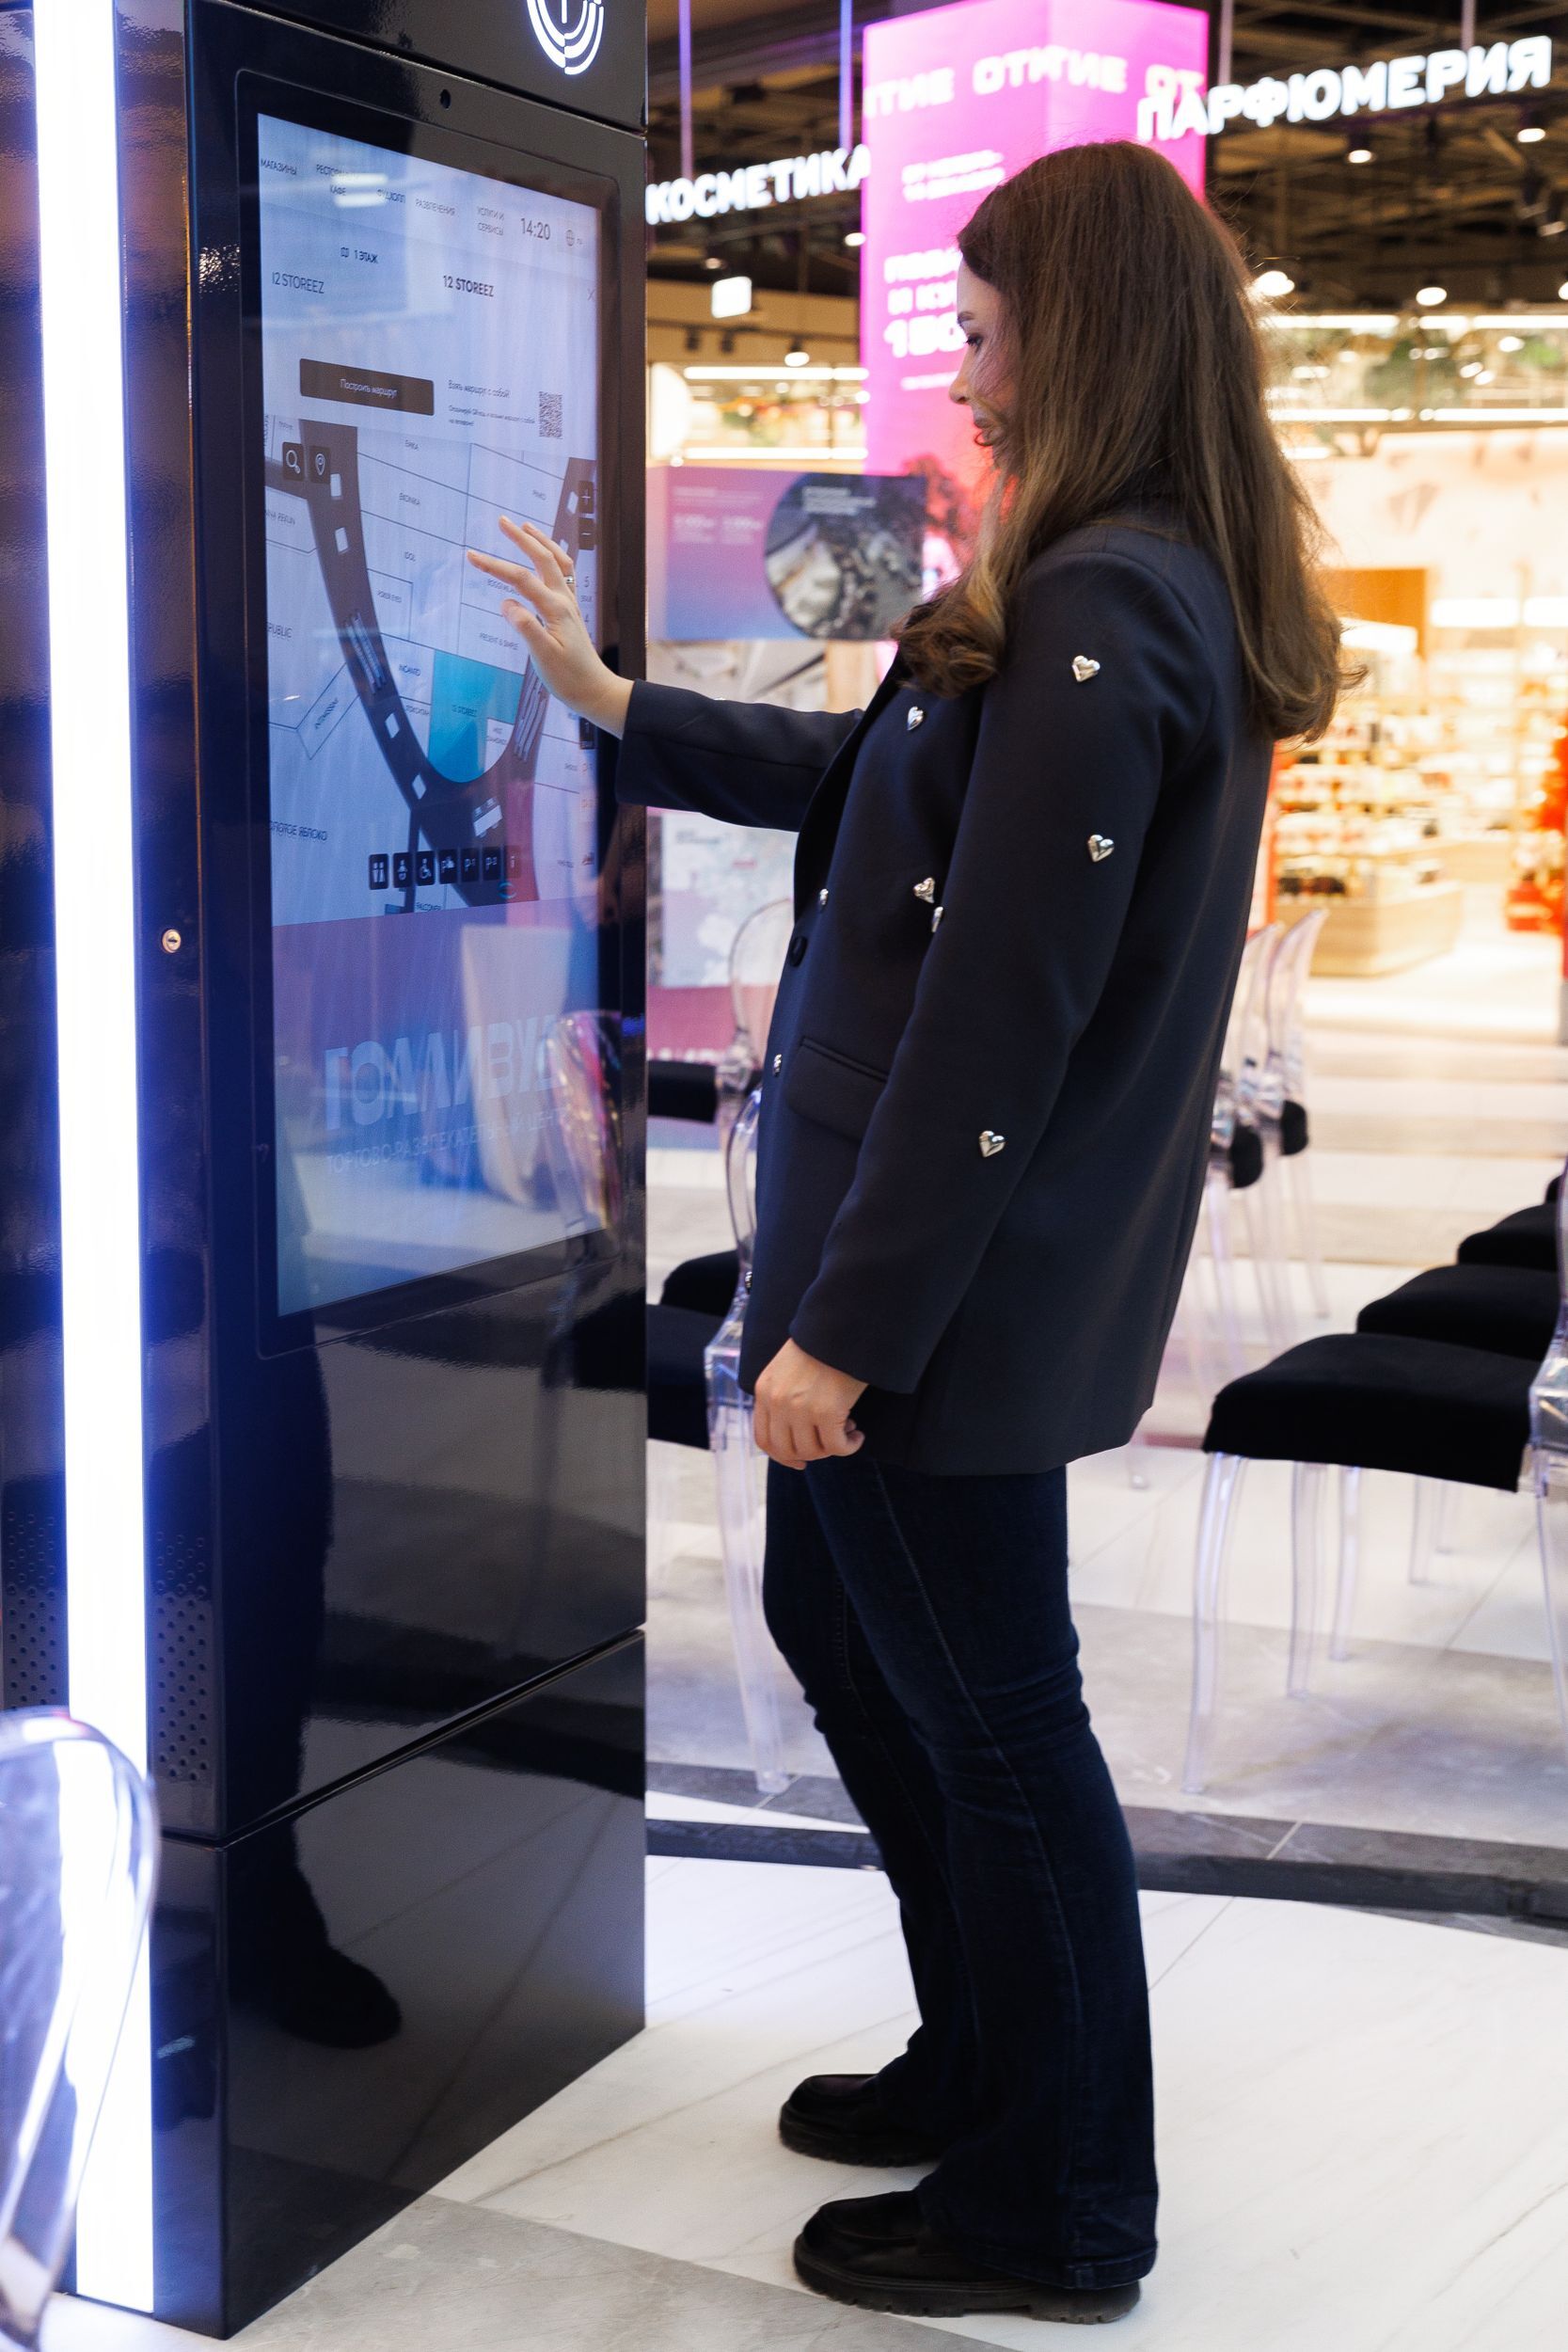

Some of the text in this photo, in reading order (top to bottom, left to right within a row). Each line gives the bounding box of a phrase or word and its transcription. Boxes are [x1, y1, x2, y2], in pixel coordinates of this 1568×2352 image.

[1136, 35, 1553, 143] ПАРФЮМЕРИЯ
[645, 143, 871, 226] КОСМЕТИКА
[520, 217, 551, 241] 14:20
[272, 272, 325, 294] 12 STOREEZ
[443, 275, 495, 297] 12 STOREEZ
